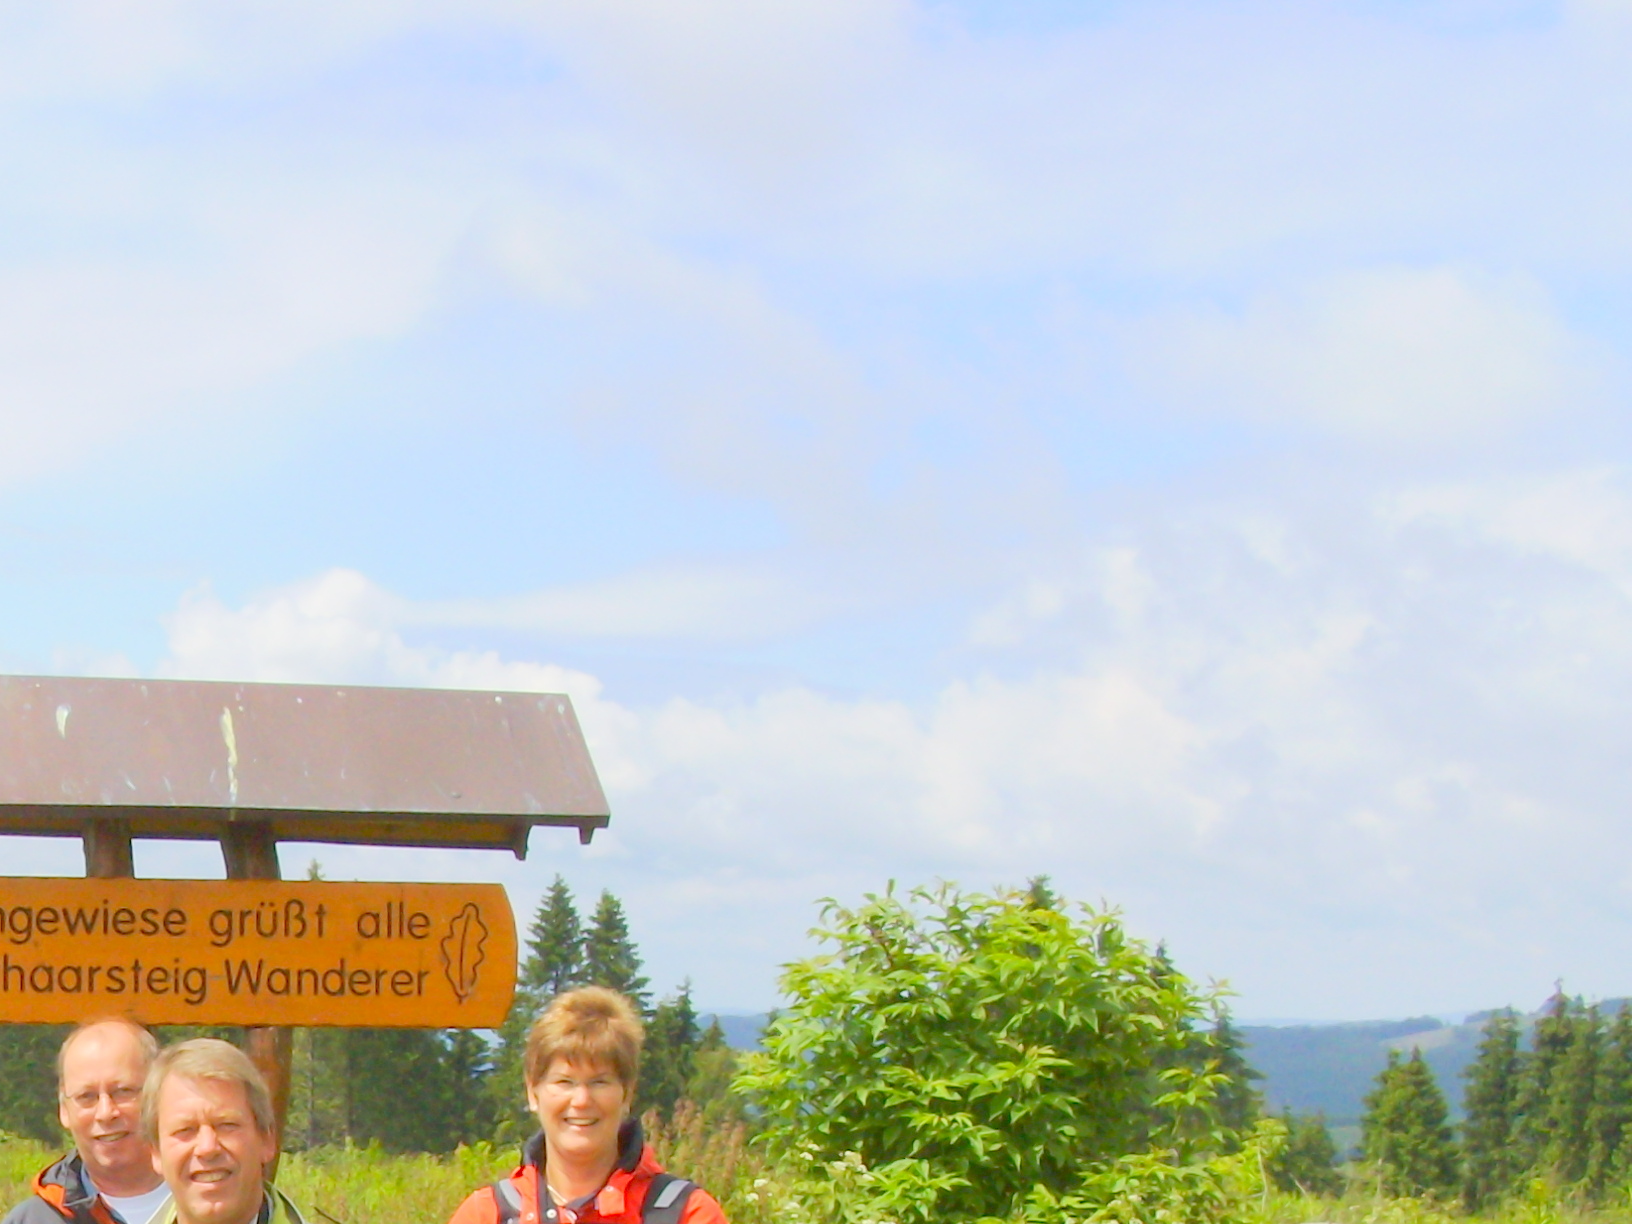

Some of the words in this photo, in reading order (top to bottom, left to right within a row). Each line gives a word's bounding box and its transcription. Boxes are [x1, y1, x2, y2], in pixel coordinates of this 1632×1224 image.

[208, 898, 327, 948] grüßt
[356, 901, 431, 940] alle
[224, 957, 430, 997] Wanderer
